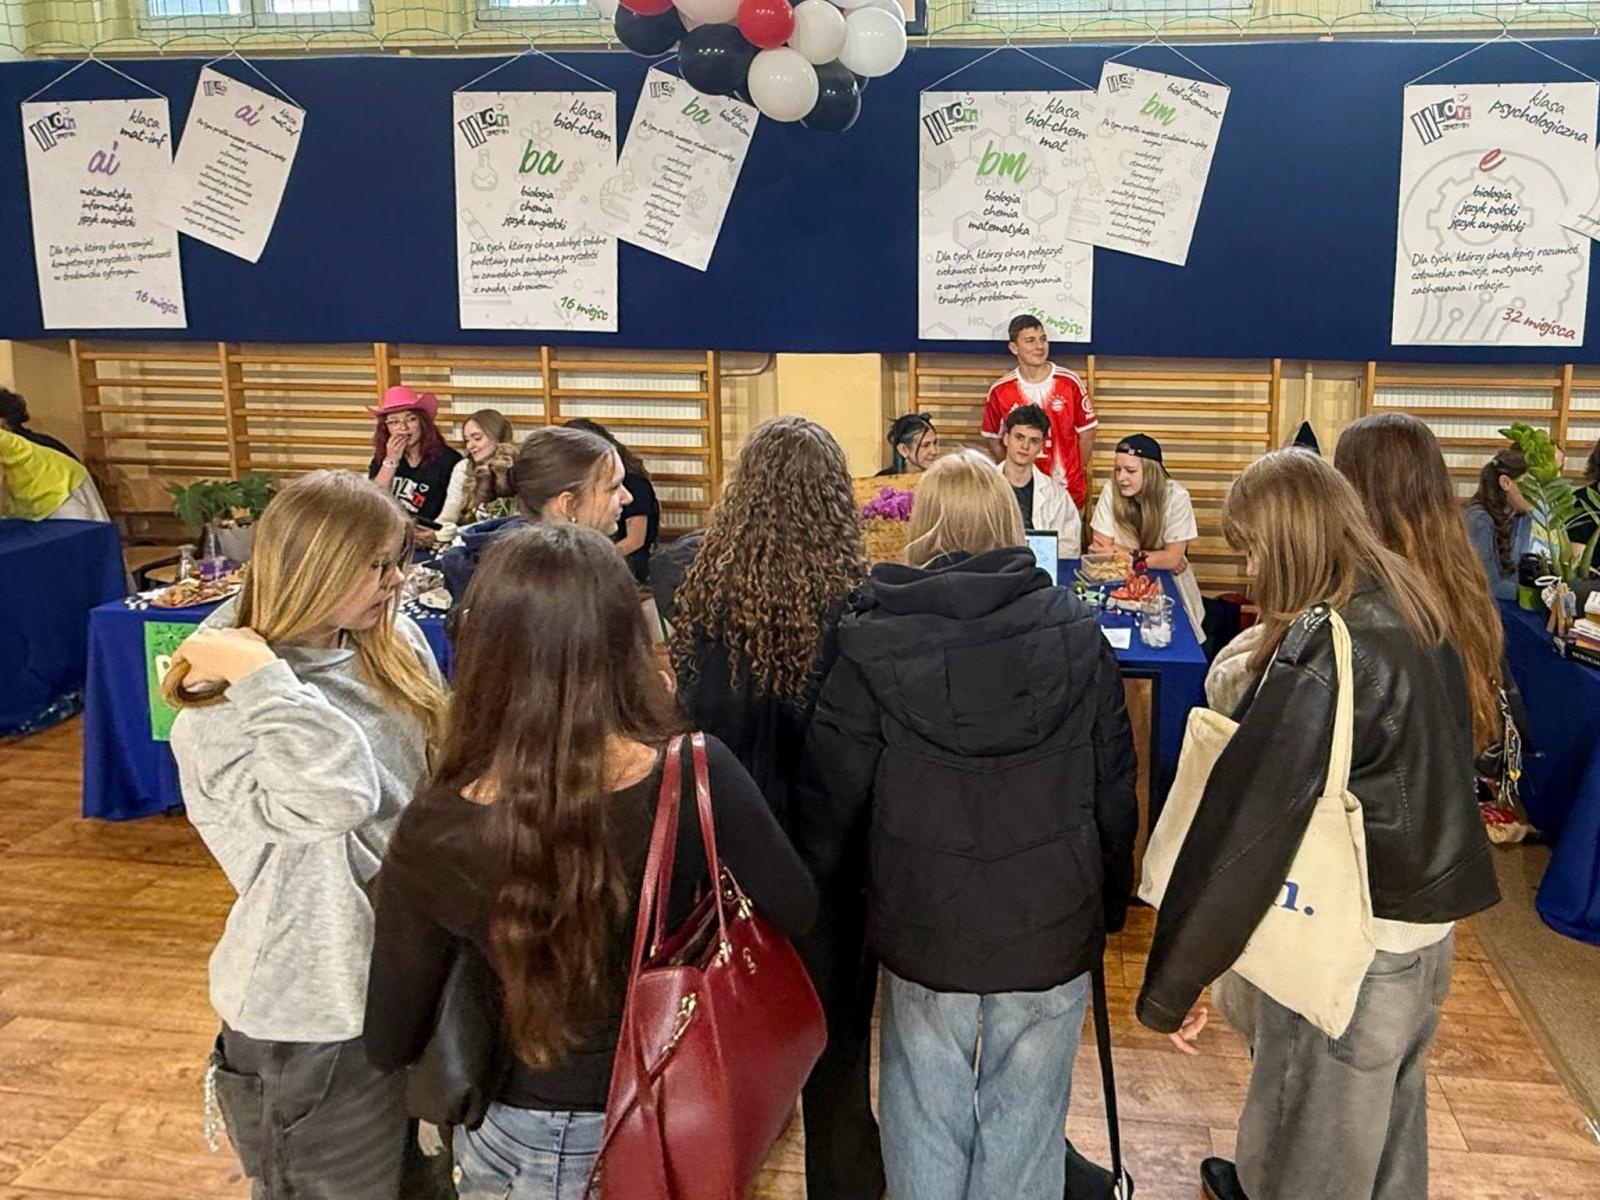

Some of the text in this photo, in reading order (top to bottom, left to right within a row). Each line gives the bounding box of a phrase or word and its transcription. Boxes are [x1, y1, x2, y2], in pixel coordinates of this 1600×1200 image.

[569, 99, 602, 122] klasa
[681, 96, 712, 125] ba
[1045, 97, 1080, 120] klasa
[1140, 92, 1177, 126] bm
[1529, 90, 1566, 115] klasa
[129, 109, 160, 128] klasa
[234, 104, 264, 127] ai
[1488, 100, 1588, 144] psychologiczna
[120, 127, 168, 149] mat-inf
[1038, 136, 1070, 152] mat
[88, 141, 120, 176] ai
[518, 139, 564, 175] ba
[976, 140, 1030, 184] bm
[1479, 149, 1506, 172] e
[520, 185, 554, 203] biologia
[985, 189, 1021, 206] biologia
[1473, 185, 1512, 202] biologia
[519, 200, 553, 214] chemia
[983, 205, 1019, 219] chemia
[1458, 200, 1520, 217] język polski
[501, 214, 568, 231] język angielski
[968, 220, 1031, 238] matematyka
[1447, 216, 1526, 233] język angielski
[470, 241, 485, 254] Dla
[509, 240, 533, 252] którzy
[535, 239, 555, 250] chcą
[936, 250, 951, 263] Dla
[976, 247, 1003, 261] którzy
[1005, 247, 1026, 259] chcą
[1411, 253, 1428, 267] Dla
[1455, 250, 1485, 264] którzy
[1487, 248, 1511, 261] chcą
[1512, 247, 1536, 261] lepiej
[1537, 243, 1580, 256] rozumieć
[1009, 259, 1047, 275] przyrody
[1491, 262, 1544, 277] motywacje,
[1411, 282, 1466, 295] zachowania
[135, 289, 178, 315] 16 miejsc
[560, 296, 609, 321] 16 miejsc
[939, 292, 976, 307] trudnych
[1046, 315, 1083, 335] miejsc
[1502, 307, 1576, 340] 32 miejsca
